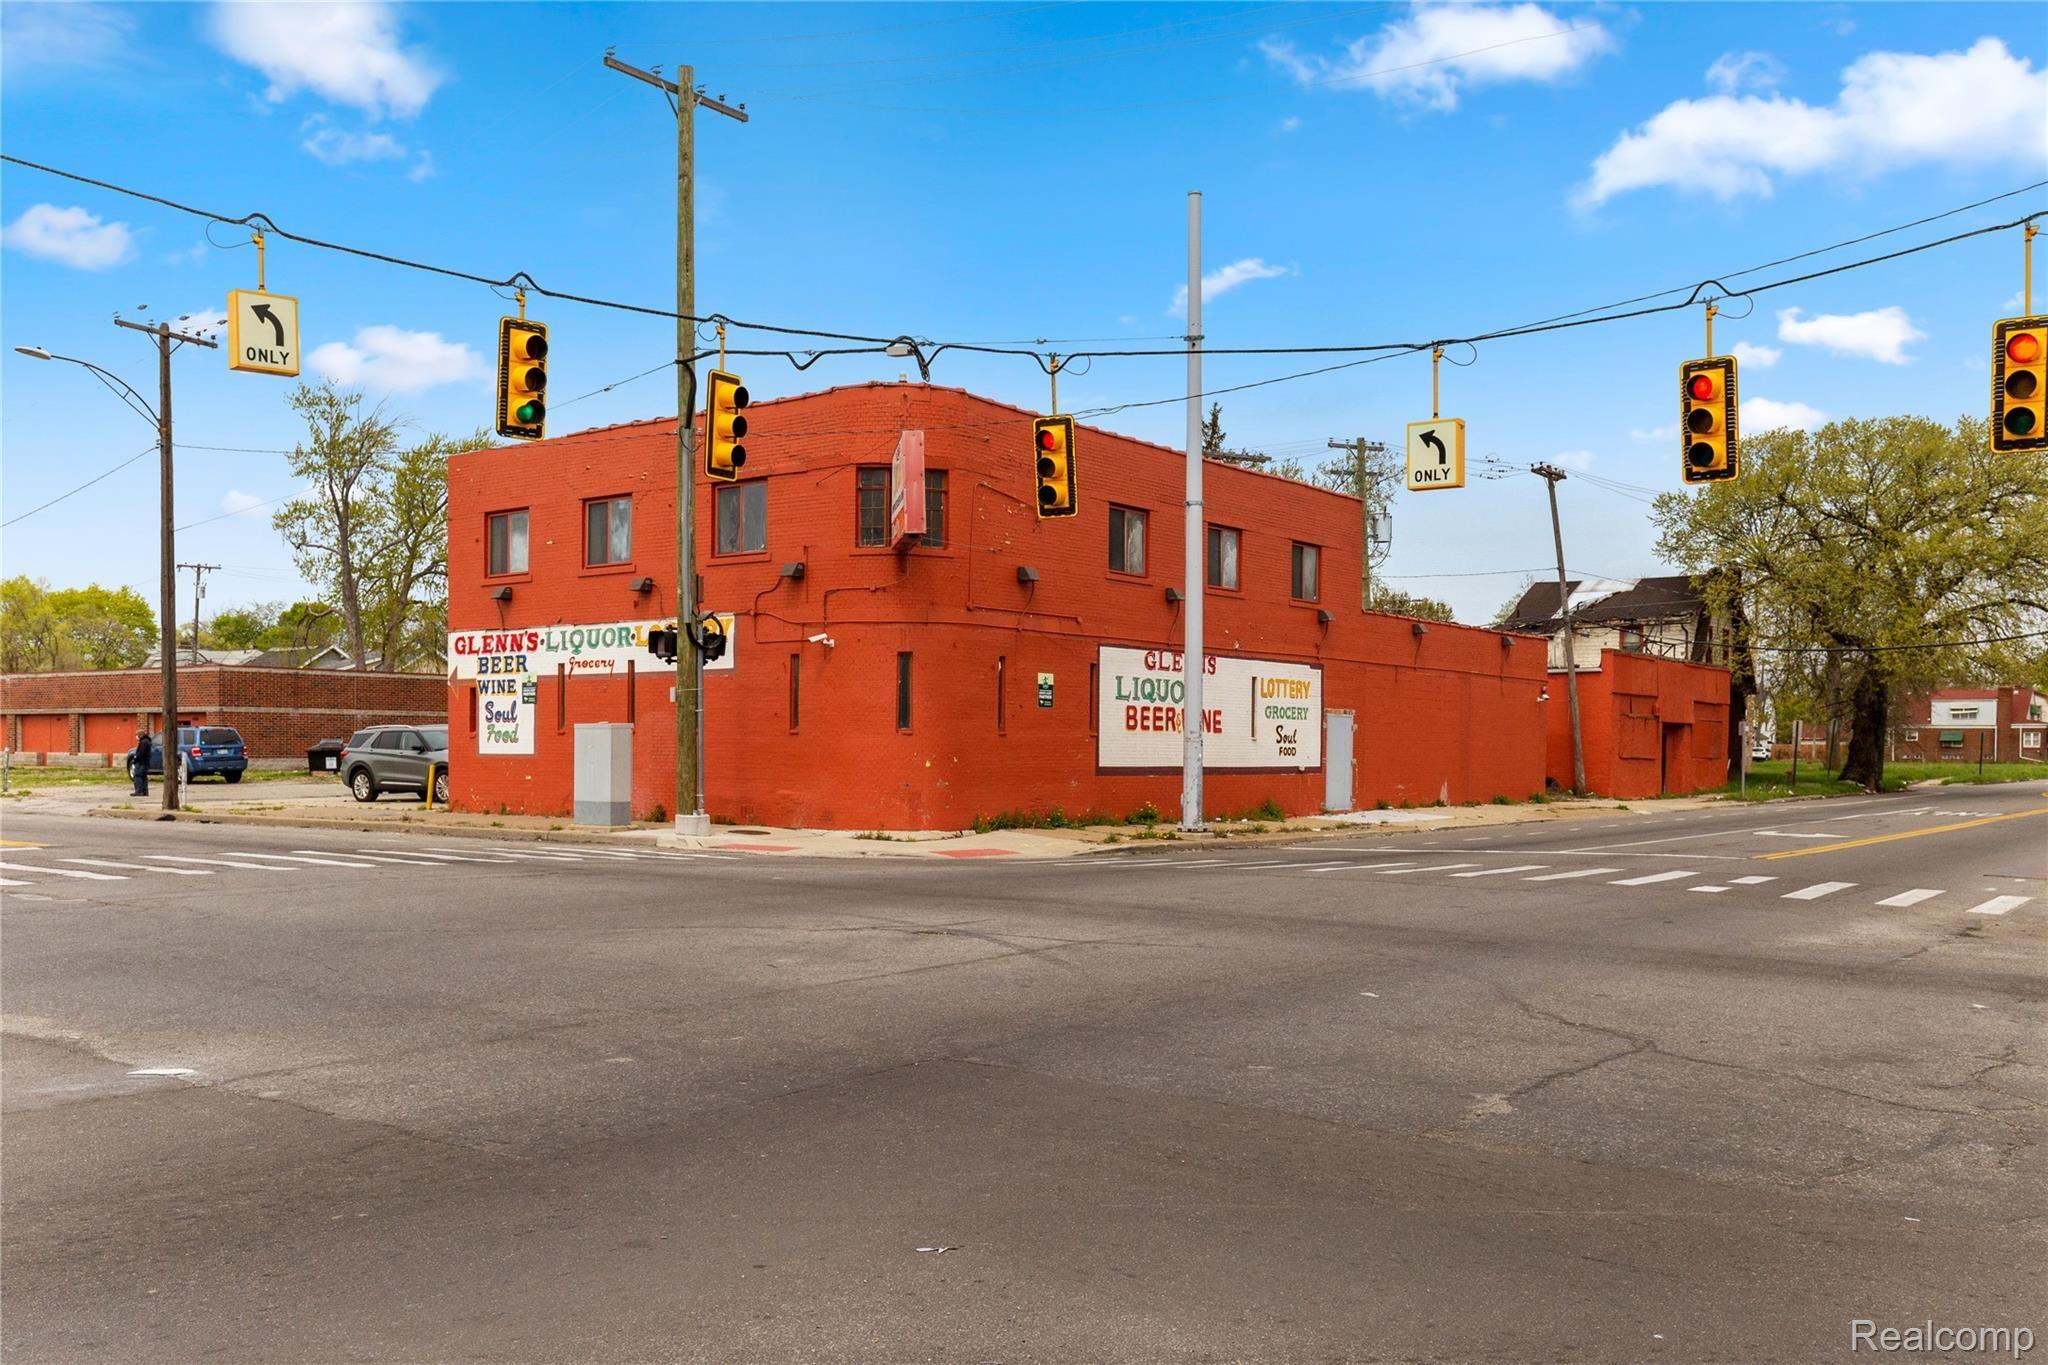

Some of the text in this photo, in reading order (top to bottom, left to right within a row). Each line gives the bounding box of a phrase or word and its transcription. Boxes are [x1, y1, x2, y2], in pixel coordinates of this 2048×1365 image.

[246, 346, 290, 365] ONLY
[1414, 467, 1450, 482] ONLY
[454, 630, 538, 656] GLENN'S
[545, 626, 632, 655] LIQUOR
[478, 655, 528, 674] BEER
[477, 679, 517, 694] WINE
[1260, 677, 1311, 699] LOTTERY
[485, 701, 517, 723] Soul
[1126, 705, 1176, 733] BEER
[1264, 706, 1309, 720] GROCERY
[486, 723, 519, 744] Food
[1275, 725, 1297, 744] Soul
[1278, 746, 1297, 757] FOOD
